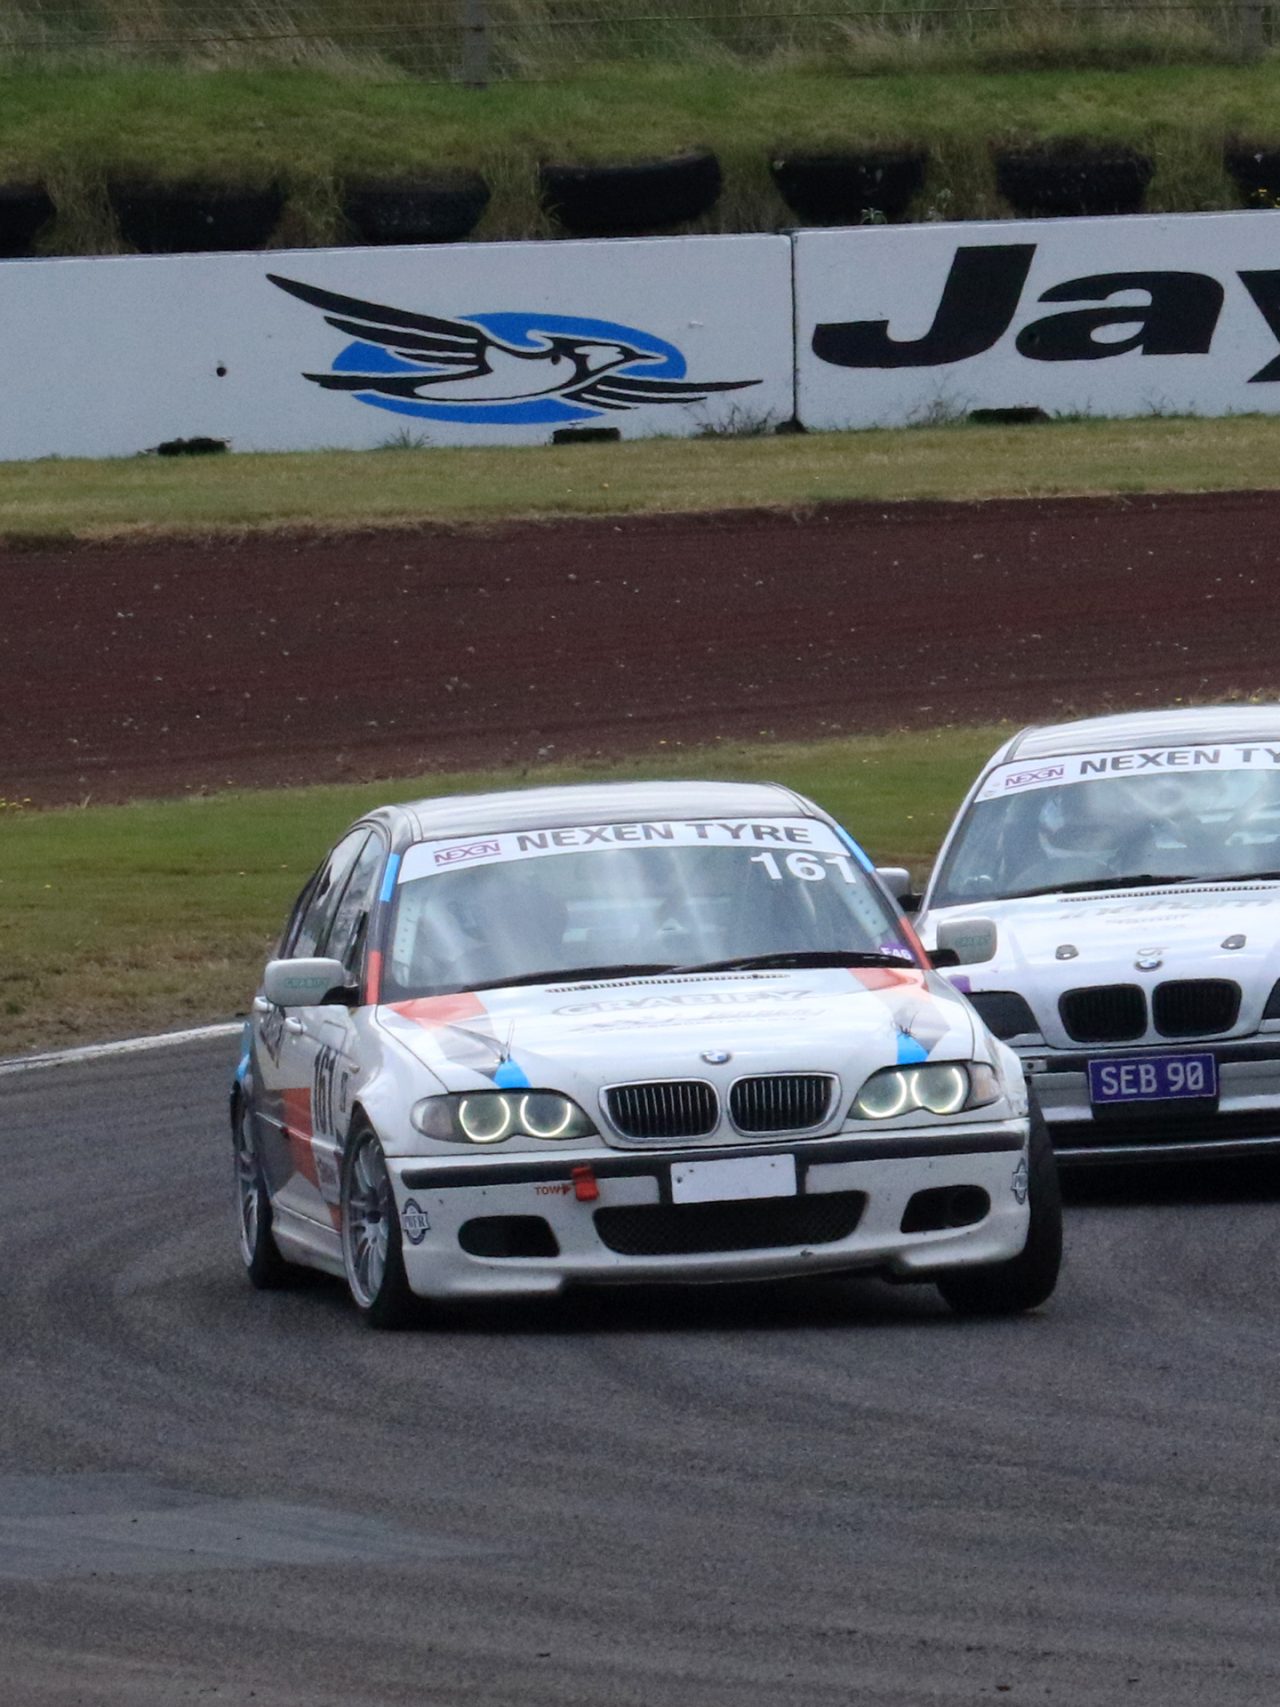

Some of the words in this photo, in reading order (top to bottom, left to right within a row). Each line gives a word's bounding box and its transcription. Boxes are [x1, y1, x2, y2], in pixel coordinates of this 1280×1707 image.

[1005, 766, 1064, 788] NEXEN
[1080, 750, 1221, 775] NEXEN
[434, 841, 502, 865] NEXEN
[516, 824, 674, 851] NEXEN
[686, 823, 812, 844] TYRE
[751, 852, 856, 884] 161
[1101, 1064, 1158, 1095] SEB
[1167, 1061, 1204, 1092] 90
[534, 1185, 561, 1196] TOW
